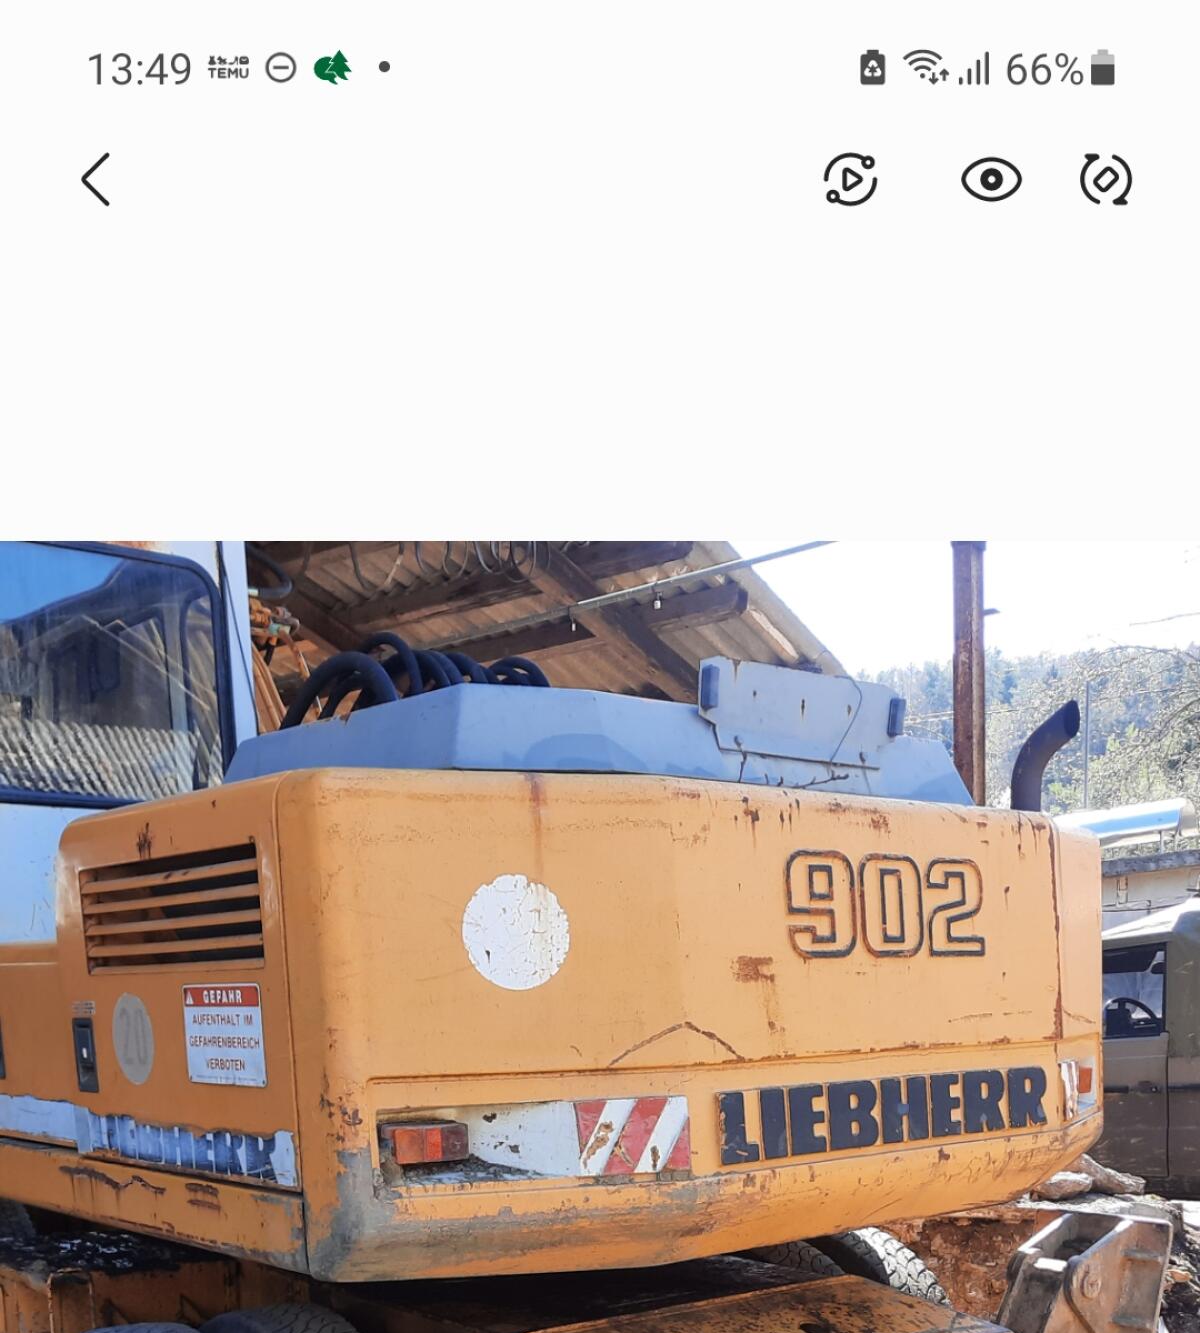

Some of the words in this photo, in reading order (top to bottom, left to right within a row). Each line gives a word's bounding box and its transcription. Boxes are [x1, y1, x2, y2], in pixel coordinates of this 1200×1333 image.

[786, 849, 985, 958] 902
[203, 990, 242, 1003] GEFAHR
[192, 1013, 240, 1026] AUFENTHALT
[244, 1014, 253, 1025] IM
[189, 1035, 260, 1049] GEFAHRENBEREICH
[206, 1058, 245, 1071] VERBOTEN
[716, 1066, 1047, 1165] LIEBHERR
